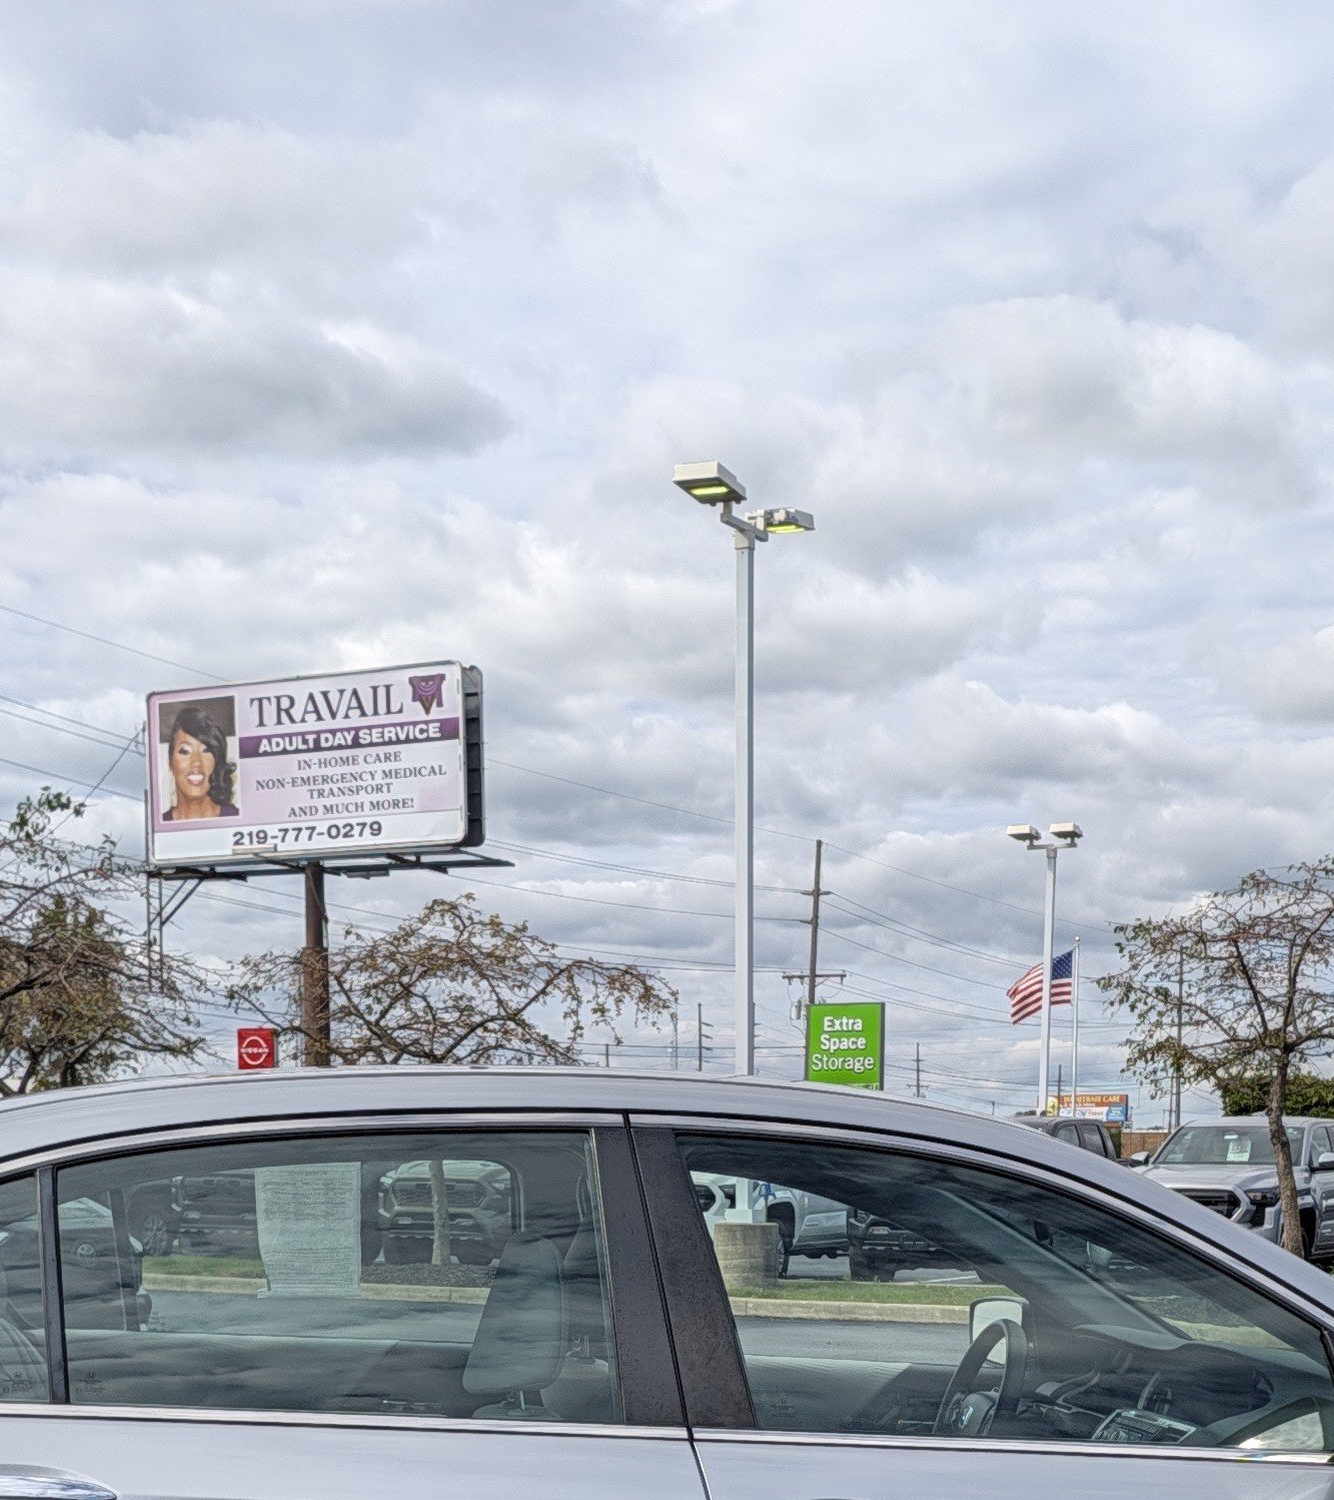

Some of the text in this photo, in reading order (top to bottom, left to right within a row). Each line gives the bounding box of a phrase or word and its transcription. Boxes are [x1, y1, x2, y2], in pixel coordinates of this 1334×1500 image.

[249, 684, 404, 728] TRAVAIL
[258, 722, 442, 754] ADULT DAY SERVICE
[297, 750, 402, 771] IN-HOME CARE
[255, 764, 447, 791] NON-EMERGENCY MEDICAL
[307, 782, 394, 800] TRANSPORT
[288, 797, 415, 818] AND MUCH MORE!
[232, 820, 383, 846] 219-777-0279
[823, 1016, 863, 1031] Extra
[820, 1033, 867, 1054] Space
[811, 1053, 875, 1073] Storage
